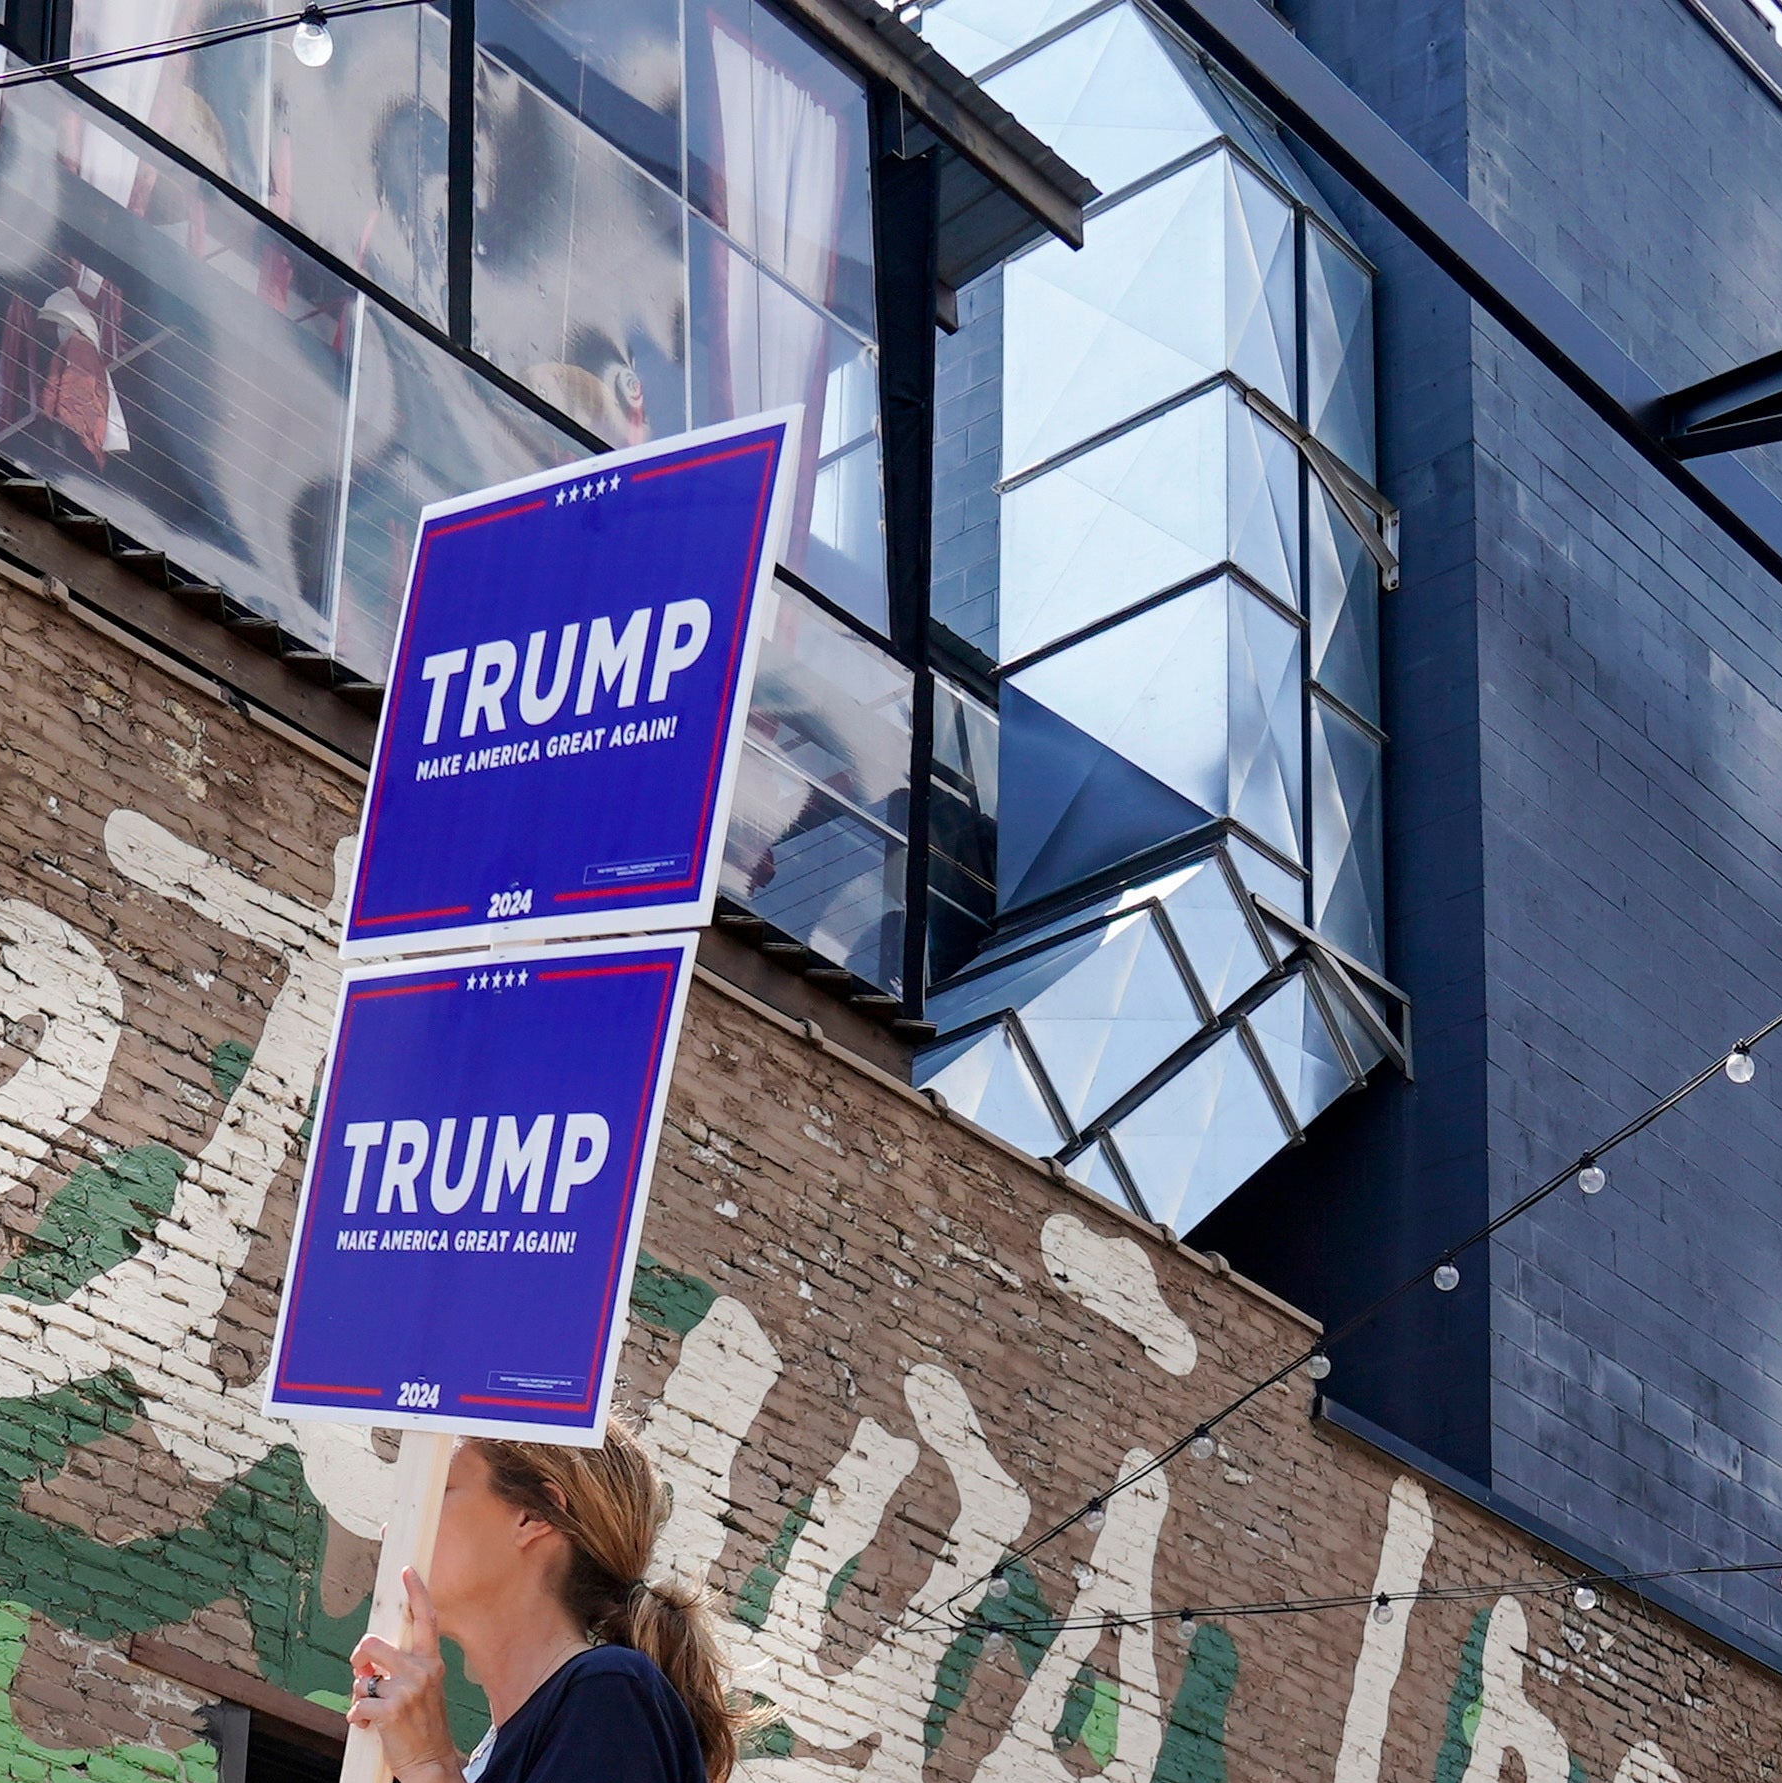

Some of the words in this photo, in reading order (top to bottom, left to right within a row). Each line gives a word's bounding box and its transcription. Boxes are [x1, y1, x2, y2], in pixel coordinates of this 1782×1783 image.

[421, 597, 712, 746] TRUMP
[415, 753, 463, 782] MAKE
[464, 739, 541, 774] AMERICA
[545, 728, 607, 759] GREAT
[609, 715, 679, 748] AGAIN!
[487, 888, 534, 919] 2024
[342, 1112, 611, 1215] TRUMP
[336, 1230, 377, 1251] MAKE
[379, 1229, 449, 1252] AMERICA
[454, 1230, 511, 1252] GREAT
[512, 1231, 578, 1254] AGAIN!
[397, 1381, 442, 1409] 2024
